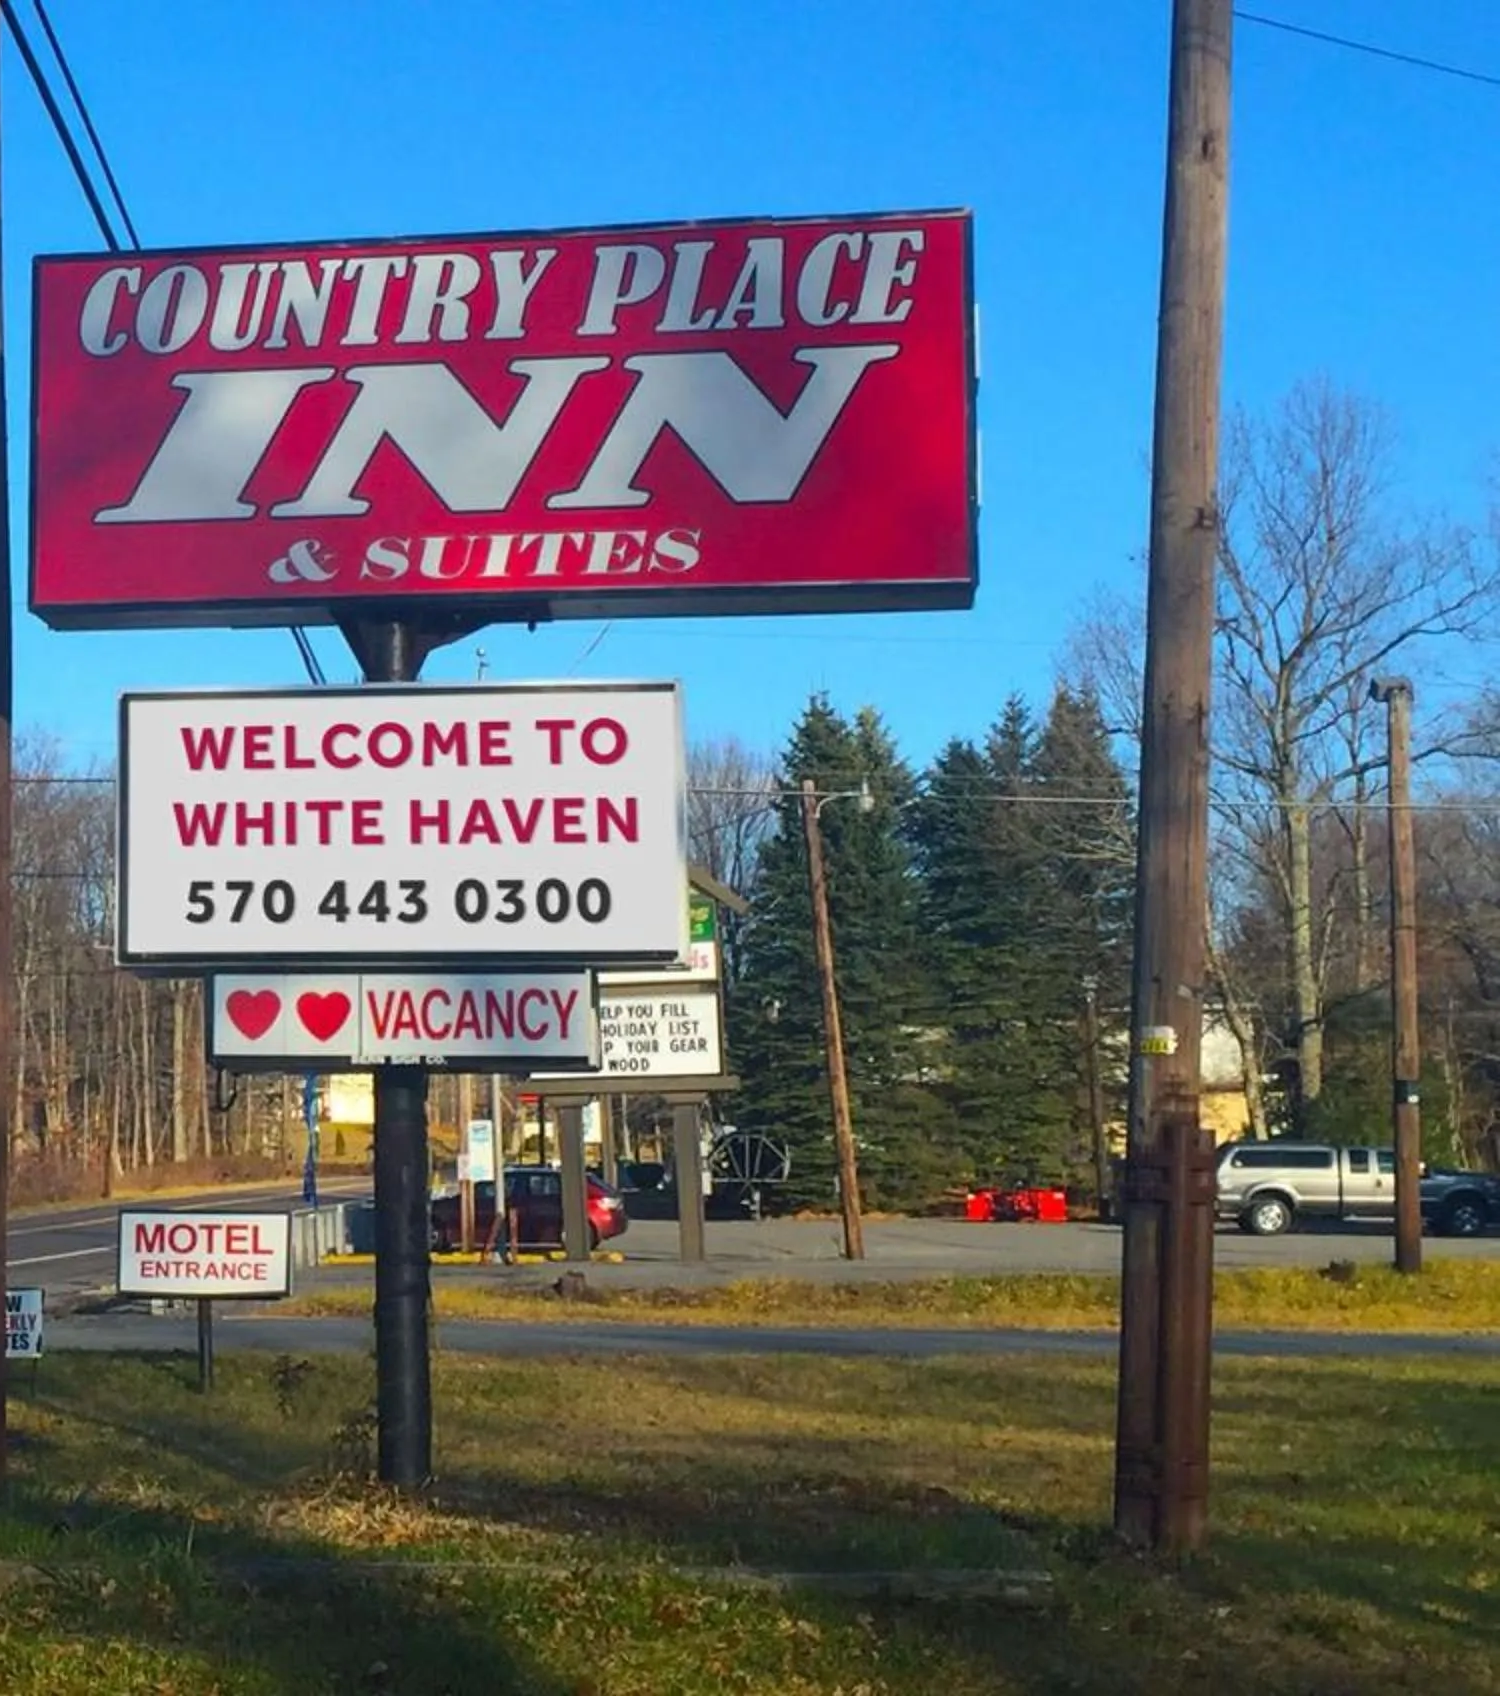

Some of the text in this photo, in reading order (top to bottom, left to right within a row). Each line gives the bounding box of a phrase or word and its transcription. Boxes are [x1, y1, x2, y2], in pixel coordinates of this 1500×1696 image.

[78, 229, 924, 355] COUNTRY PLACE
[93, 343, 900, 524] INN
[268, 527, 703, 582] & SUITES
[180, 717, 629, 770] WELCOME TO
[172, 796, 639, 847] WHITE HAVEN
[185, 877, 612, 923] 570 443 0300
[367, 988, 577, 1041] VACANCY
[601, 1003, 690, 1020] ELP YOU FILL
[669, 1021, 700, 1035] LIST
[608, 1058, 650, 1072] WOOD
[627, 1039, 659, 1054] YOUR
[670, 1038, 707, 1053] GEAR
[135, 1223, 274, 1255] MOTEL
[140, 1261, 267, 1281] ENTRANCE
[4, 1333, 30, 1351] TES
